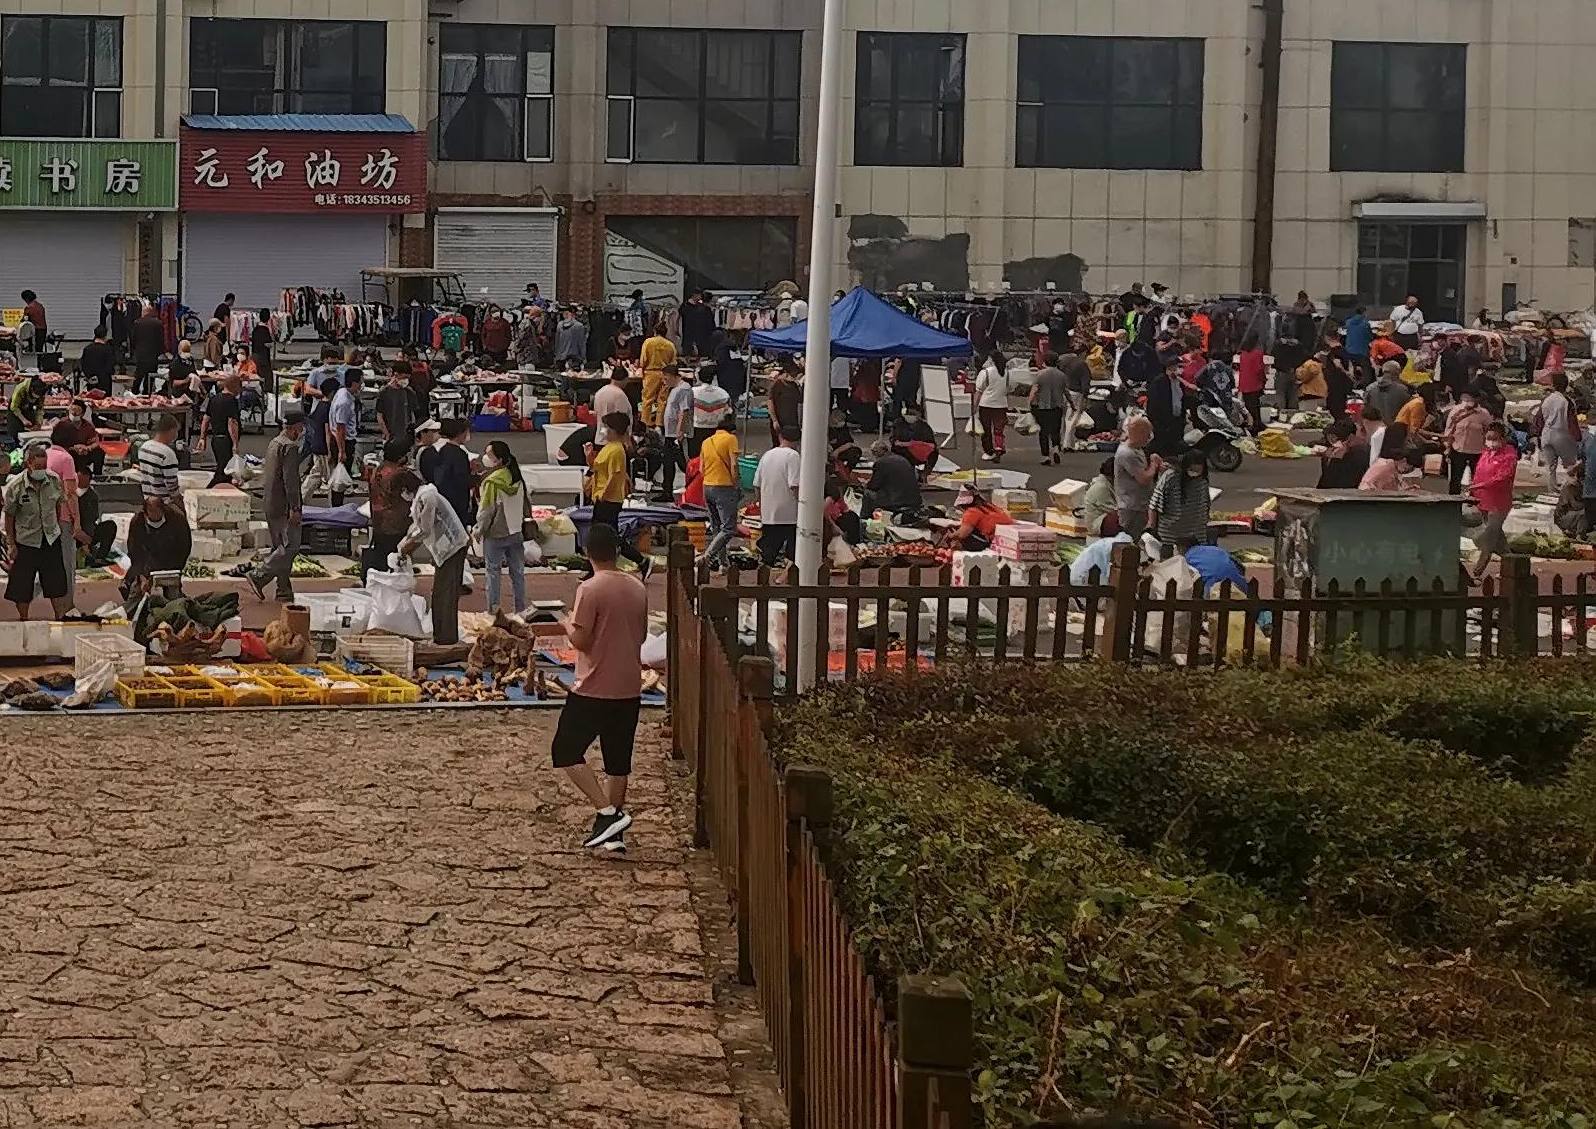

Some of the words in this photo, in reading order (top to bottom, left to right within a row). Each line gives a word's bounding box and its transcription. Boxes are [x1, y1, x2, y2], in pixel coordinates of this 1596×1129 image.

[193, 146, 400, 191] 元和油坊
[314, 193, 412, 206] 电话:18343513456
